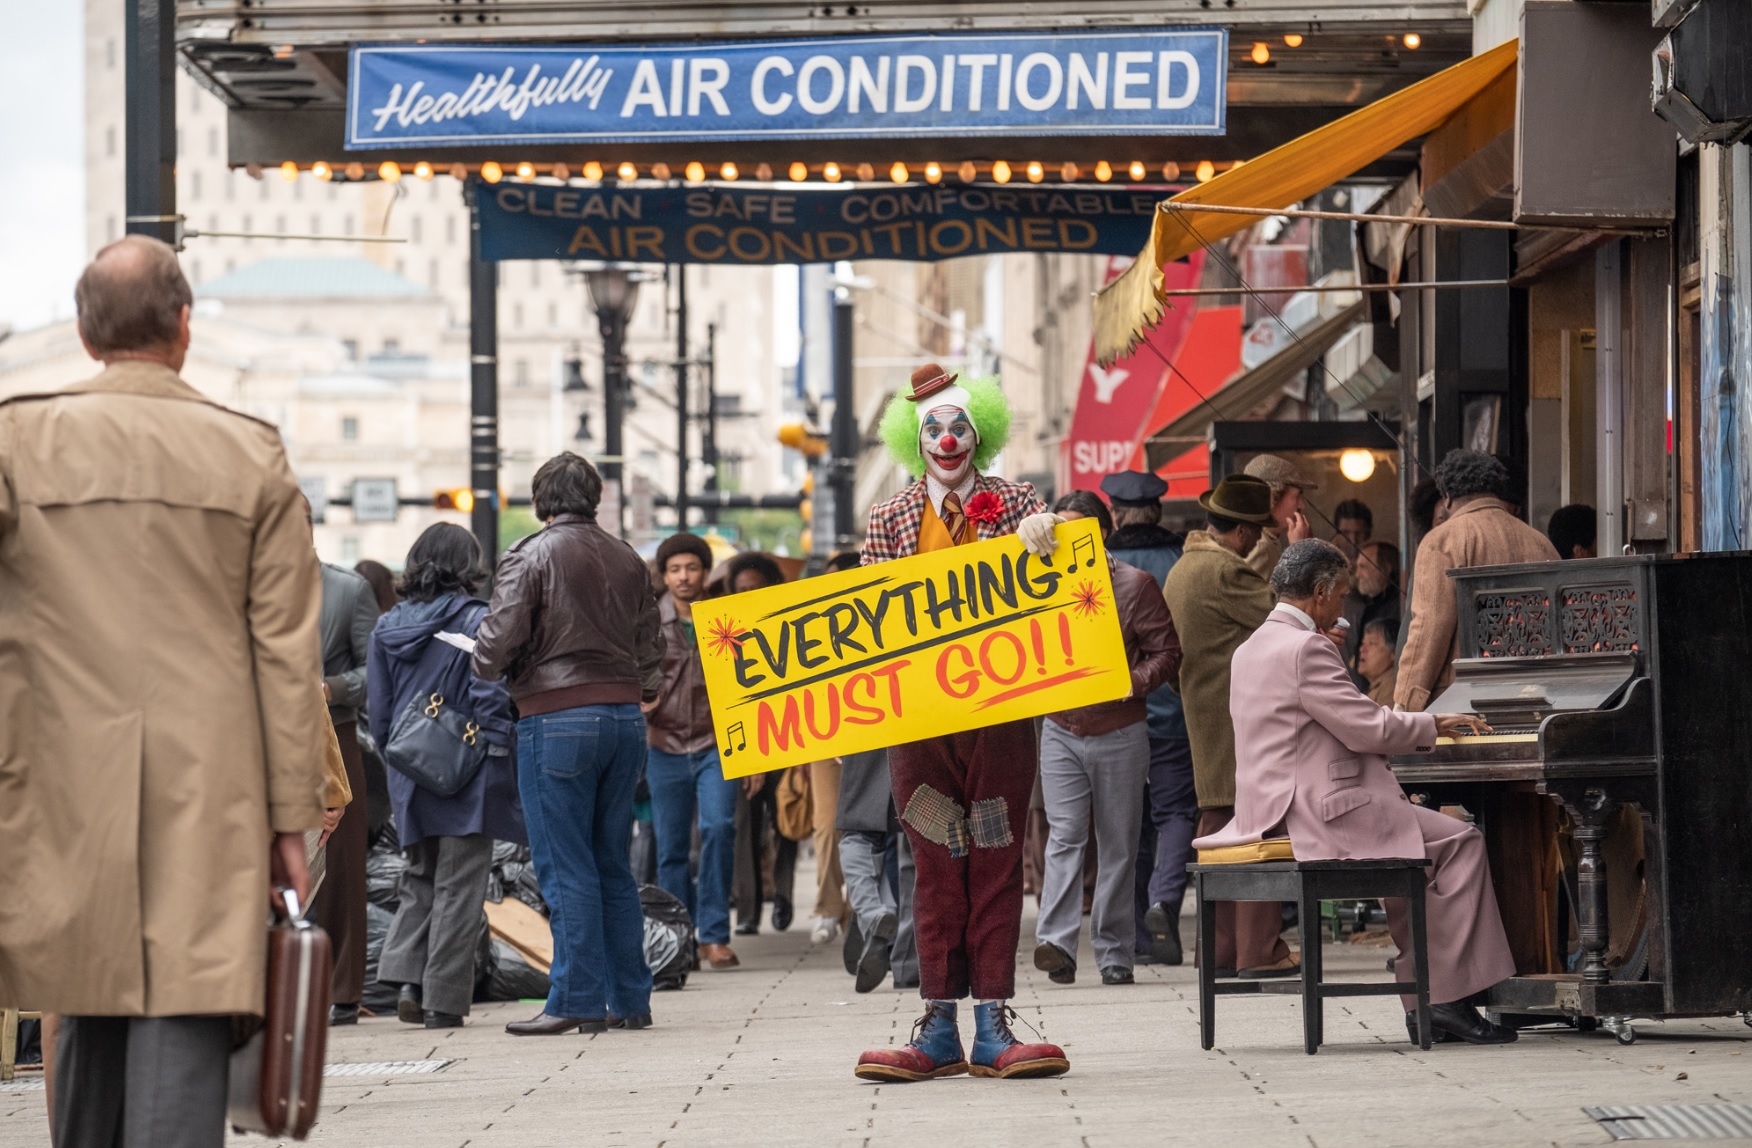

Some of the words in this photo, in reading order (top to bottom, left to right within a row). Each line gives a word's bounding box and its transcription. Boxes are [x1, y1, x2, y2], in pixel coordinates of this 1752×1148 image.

[372, 54, 614, 132] Healthfully
[619, 57, 732, 118] AIR
[750, 50, 1201, 116] CONDITIONED
[496, 187, 642, 221] CLEAN
[685, 192, 797, 225] SAFE
[840, 187, 1155, 224] COMFORTABLE
[567, 224, 667, 259] AIR
[684, 216, 1098, 262] CONDITIONED
[733, 549, 1064, 689] EVERYTHING
[756, 659, 912, 757] MUST
[935, 611, 1076, 700] GO!!
